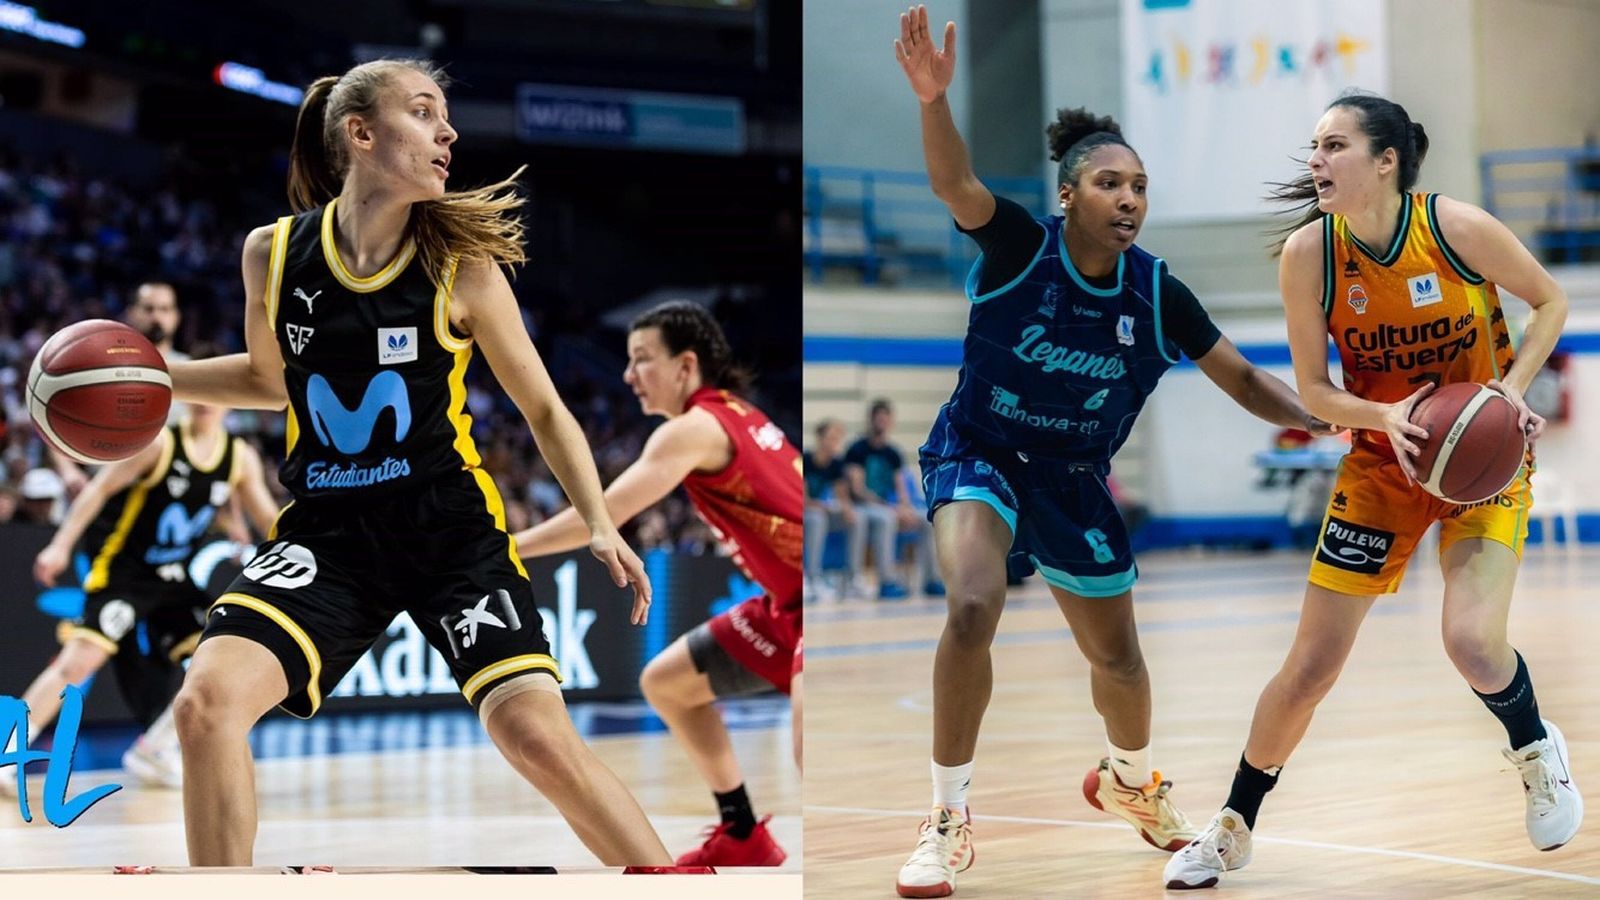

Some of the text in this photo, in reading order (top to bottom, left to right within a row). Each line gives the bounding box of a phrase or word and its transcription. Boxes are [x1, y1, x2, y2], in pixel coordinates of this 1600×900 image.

[1344, 307, 1474, 350] Cultura del
[1012, 324, 1127, 379] Leganés
[1355, 327, 1477, 373] Esfuerzo
[1083, 388, 1109, 411] 6
[306, 456, 411, 490] Estudiantes
[1326, 521, 1387, 551] PULEVA
